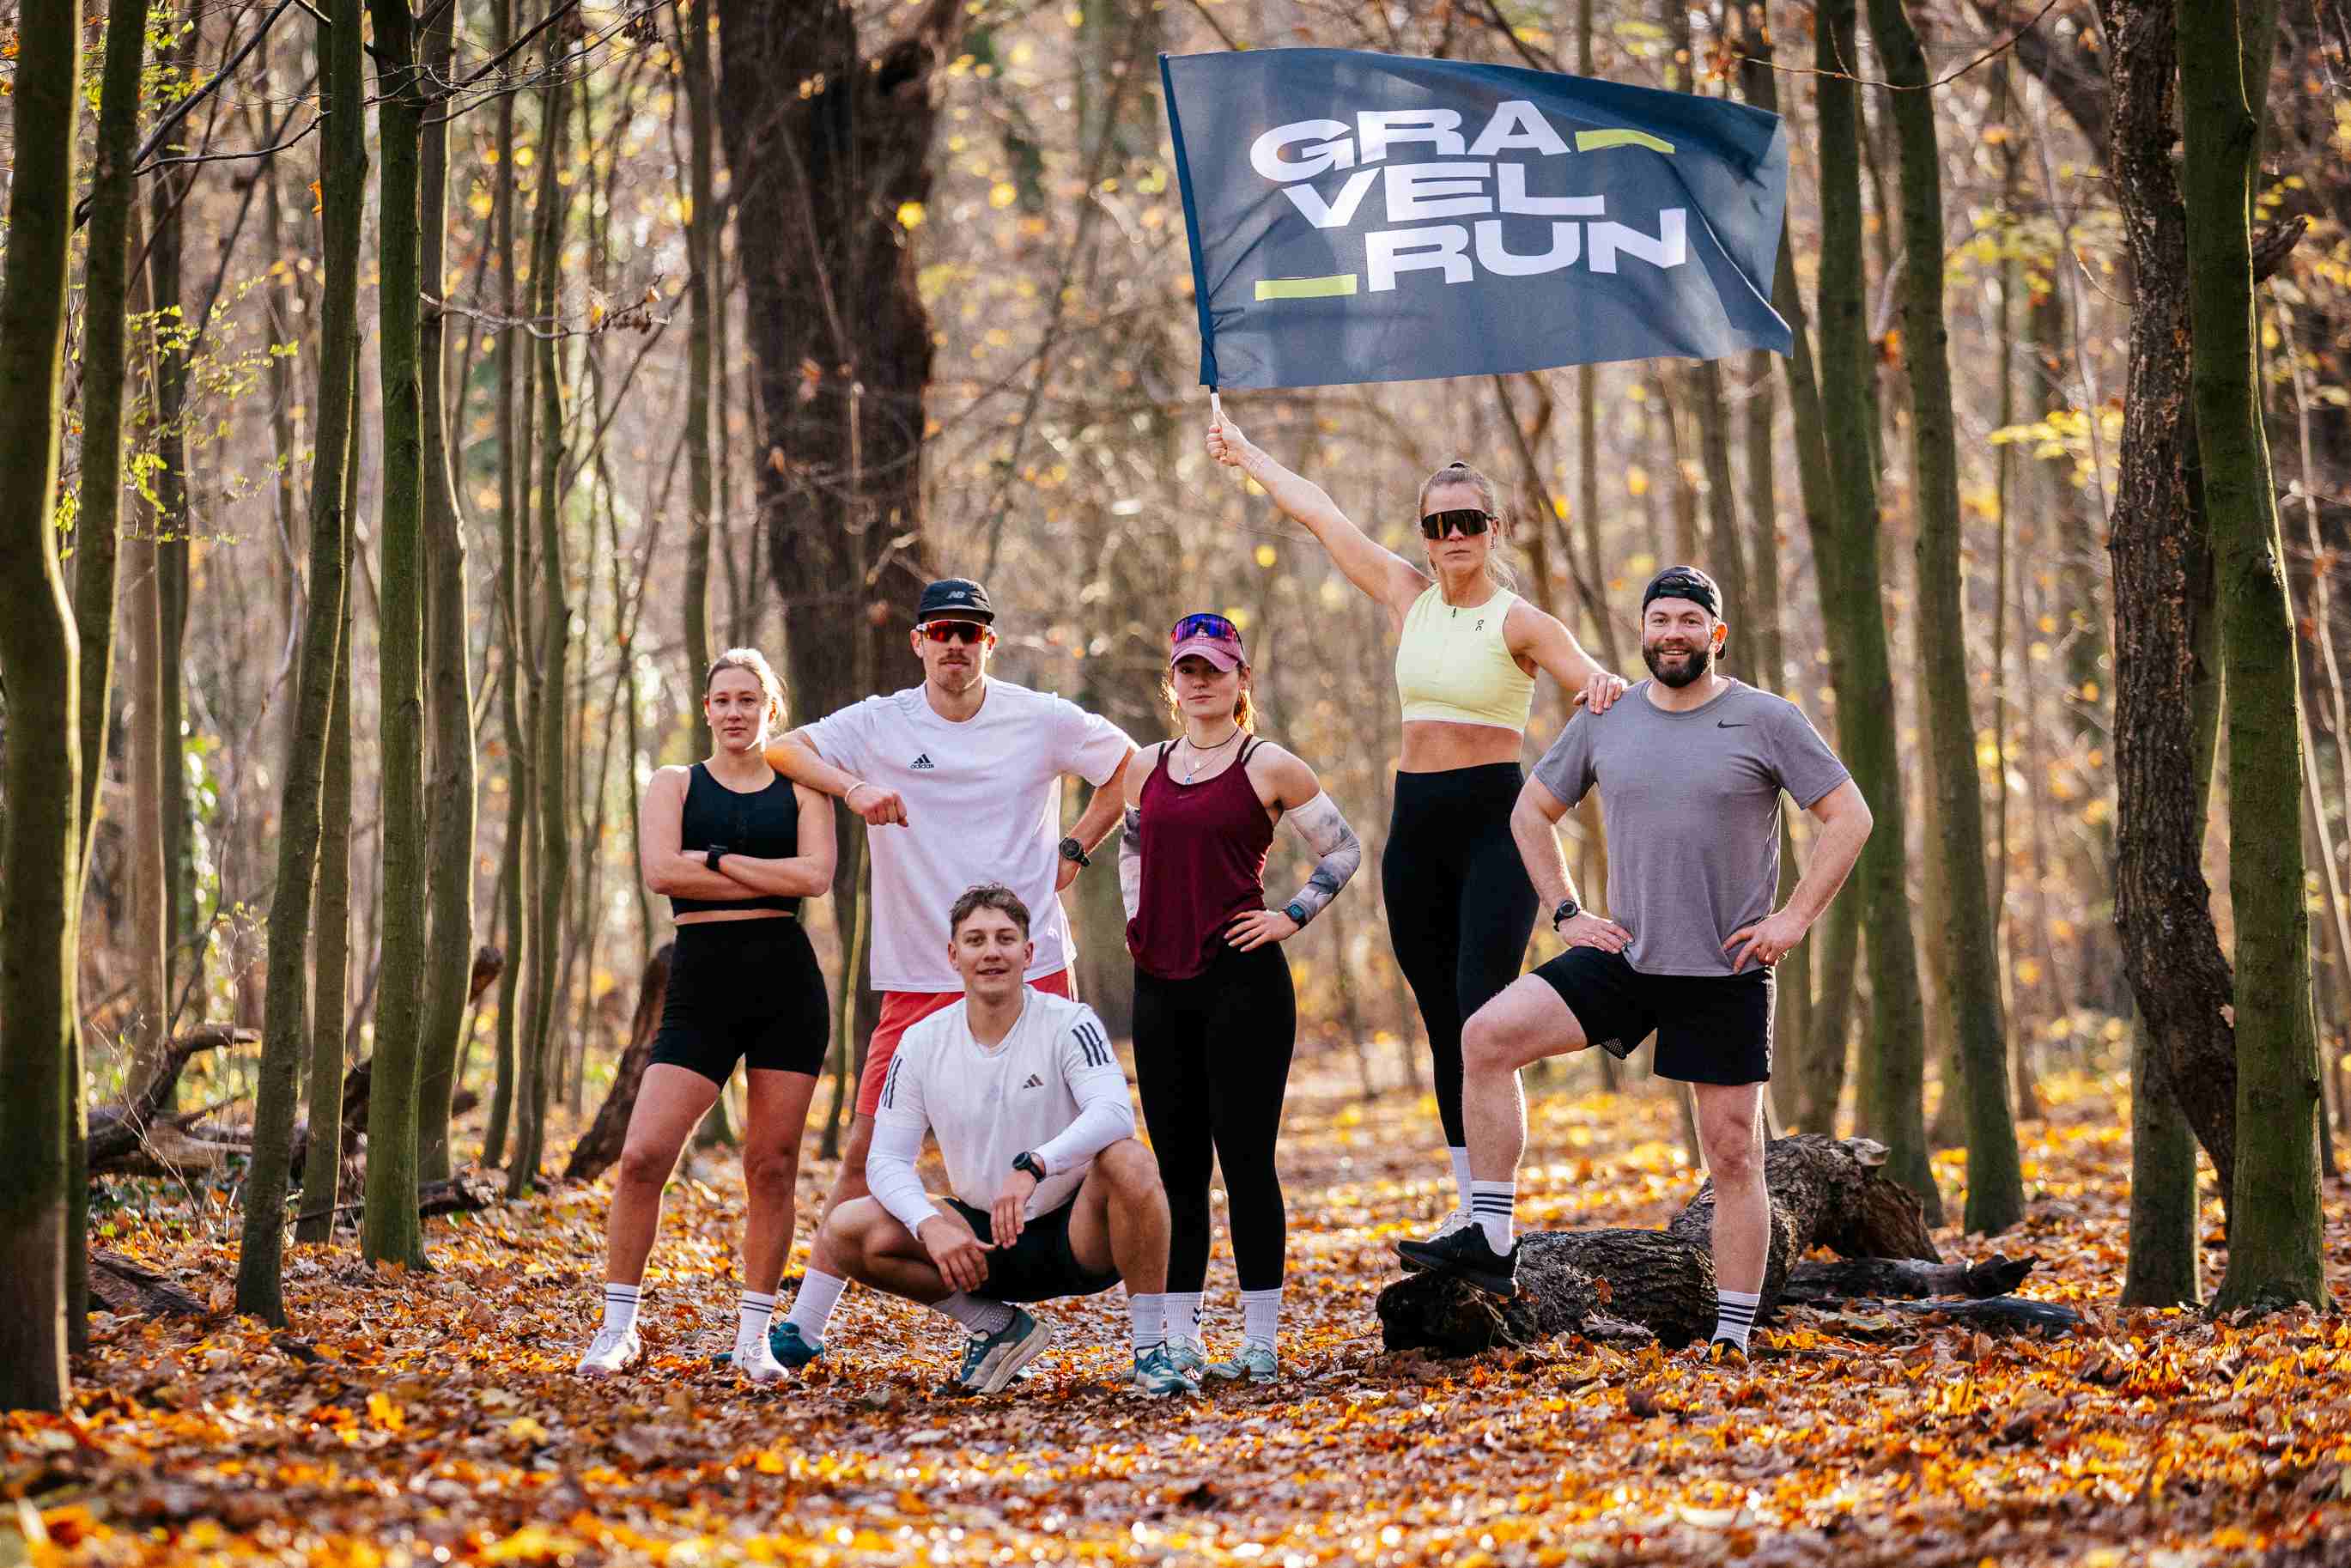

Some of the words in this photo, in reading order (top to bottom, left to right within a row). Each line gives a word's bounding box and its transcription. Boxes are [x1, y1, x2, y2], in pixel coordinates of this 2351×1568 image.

[1249, 100, 1571, 182] GRA
[1282, 161, 1605, 228] VEL
[1364, 208, 1687, 293] RUN
